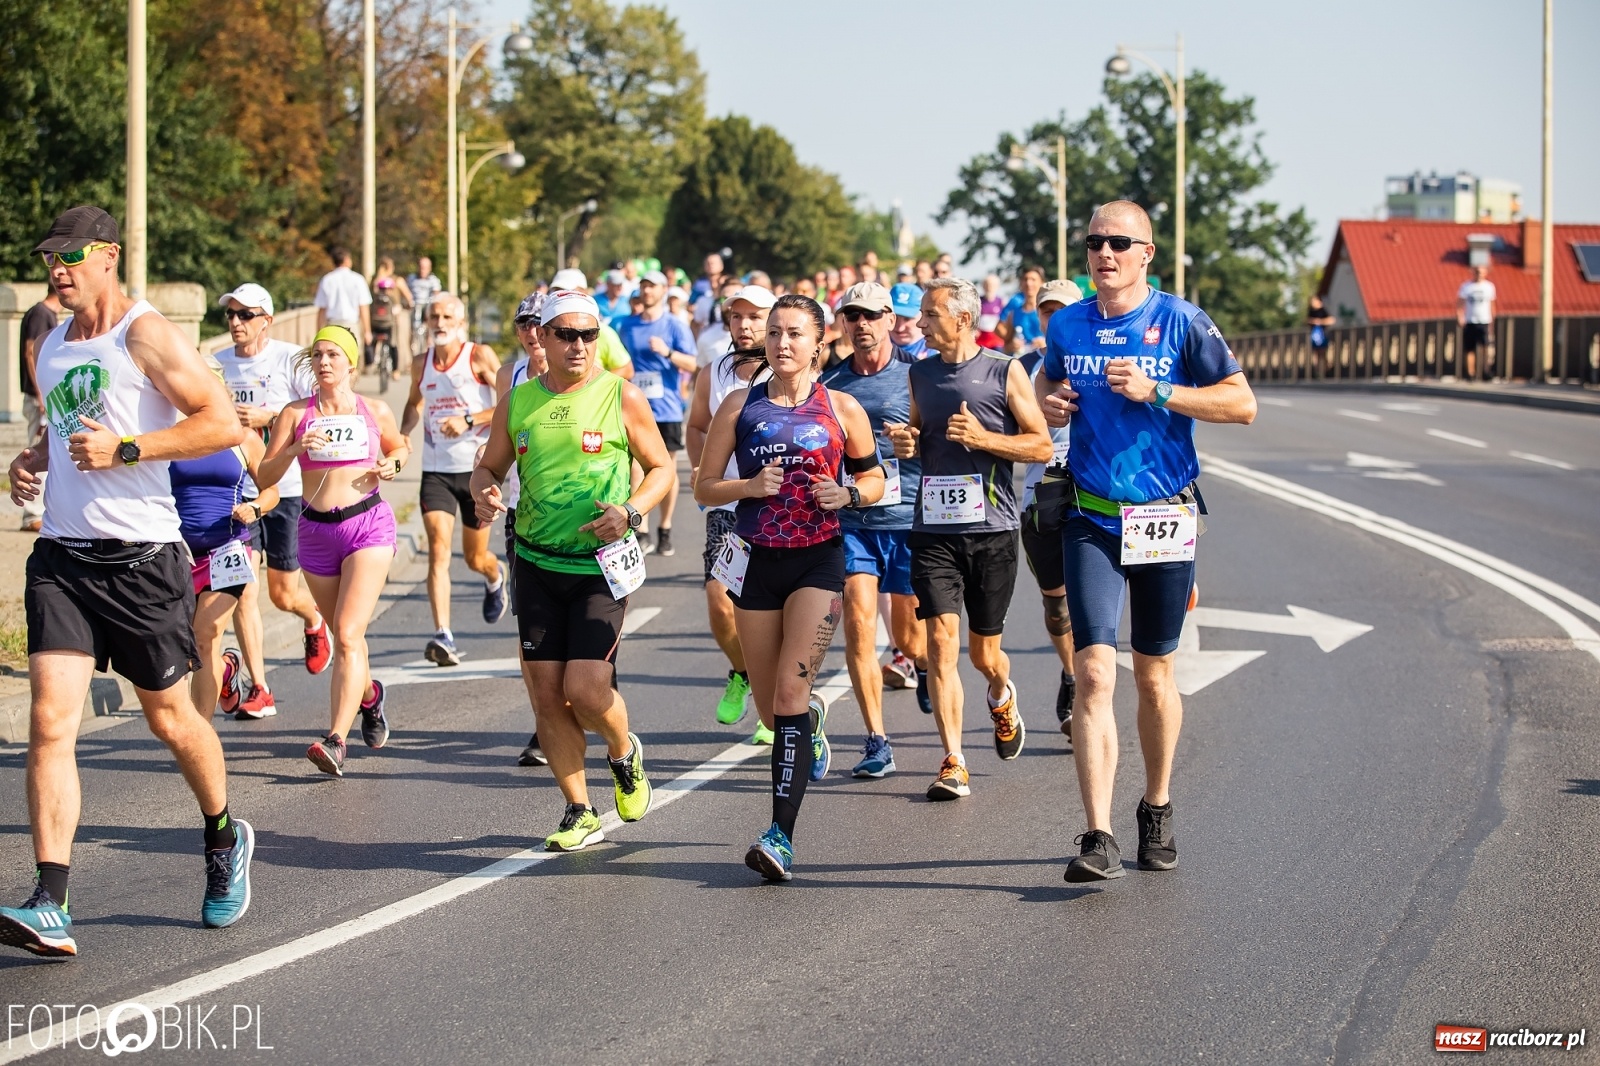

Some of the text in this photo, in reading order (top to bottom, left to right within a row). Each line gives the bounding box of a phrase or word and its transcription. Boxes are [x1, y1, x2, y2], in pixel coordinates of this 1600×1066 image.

[1063, 355, 1173, 377] RUNRS
[1071, 379, 1111, 388] EKO-OKN
[235, 390, 253, 402] 201
[750, 443, 787, 457] YNO
[761, 456, 816, 466] UTRA
[940, 489, 967, 505] 153
[1144, 521, 1179, 540] 457
[775, 726, 801, 798] Kalenji
